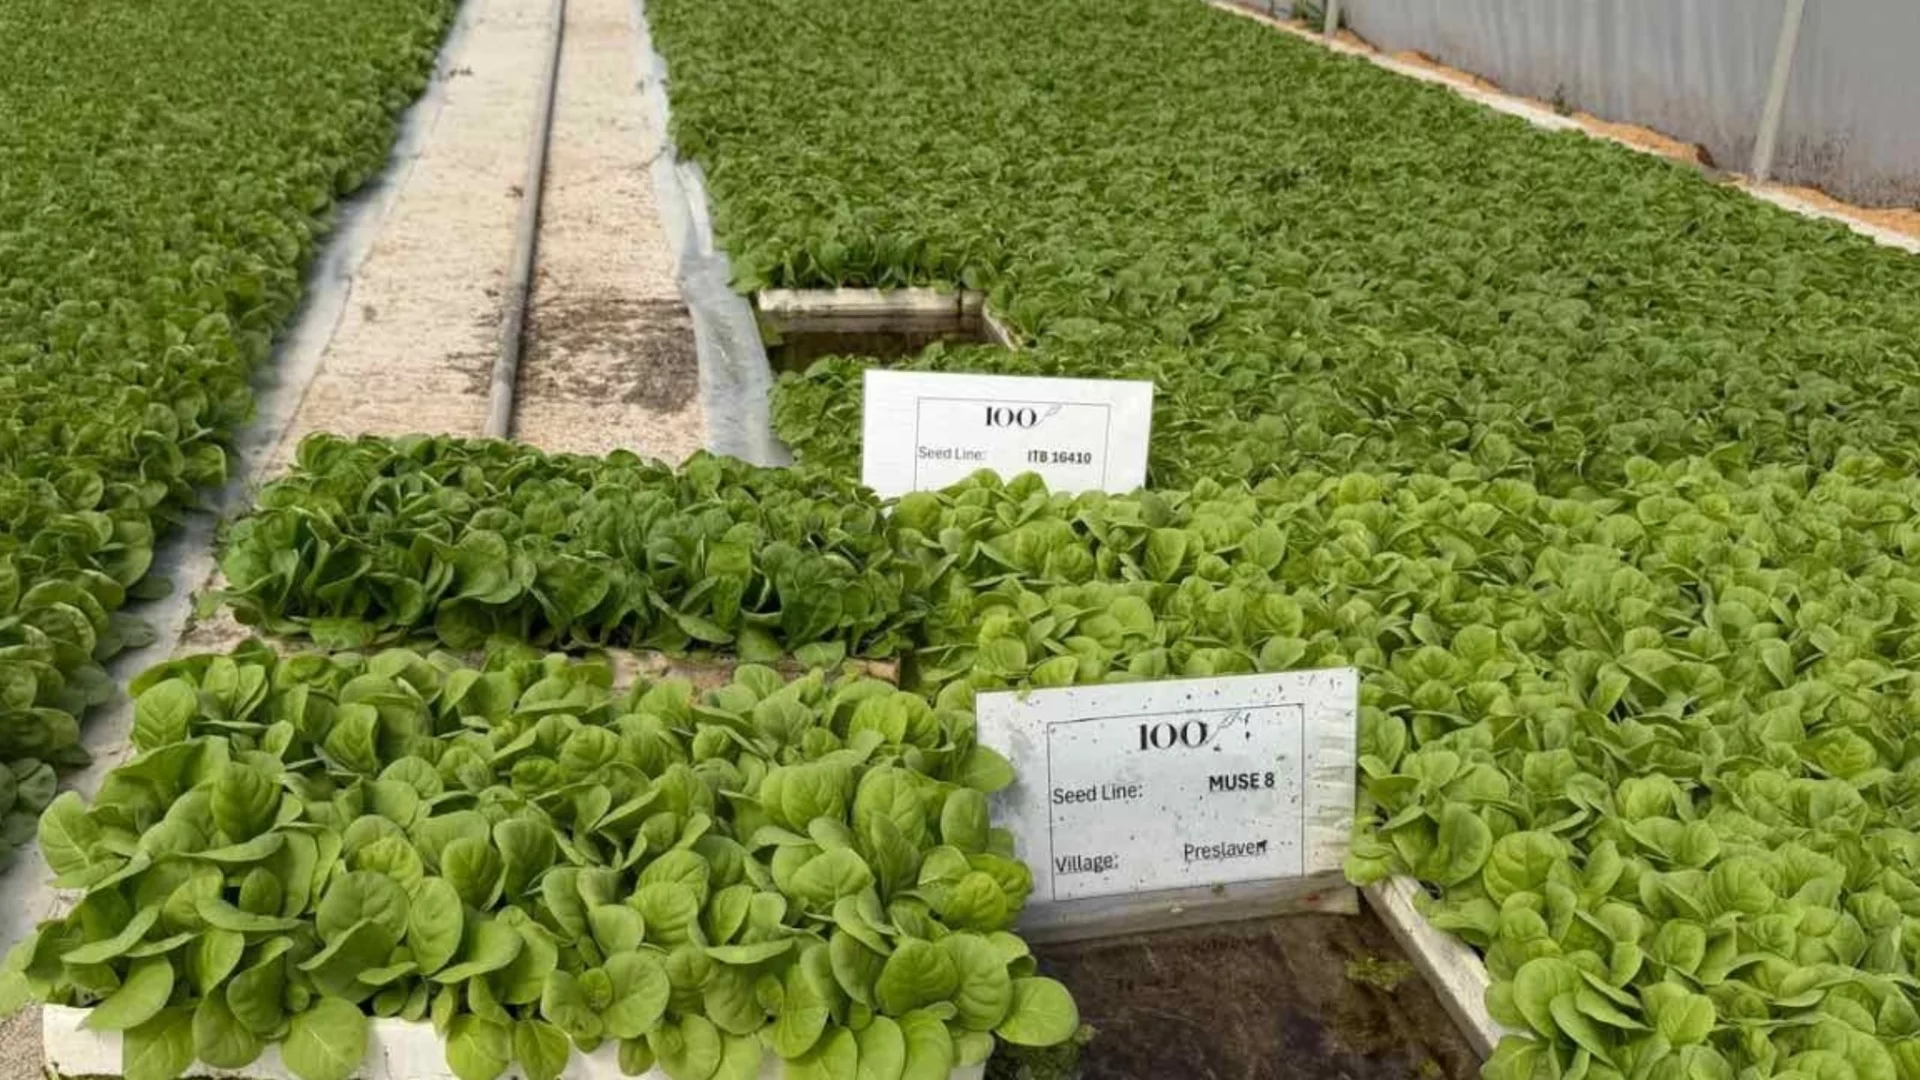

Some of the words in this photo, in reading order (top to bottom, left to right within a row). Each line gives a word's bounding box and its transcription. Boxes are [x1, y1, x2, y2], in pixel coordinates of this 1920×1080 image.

[985, 406, 1038, 429] 100
[918, 445, 951, 460] Seed
[954, 446, 987, 461] Line:
[1027, 449, 1048, 464] ITB
[1052, 451, 1092, 465] 16410
[1139, 720, 1208, 751] 100
[1052, 784, 1097, 805] Seed
[1101, 782, 1143, 801] Line:
[1209, 772, 1260, 792] MUSE
[1264, 771, 1275, 788] 8
[1054, 853, 1119, 874] Village:
